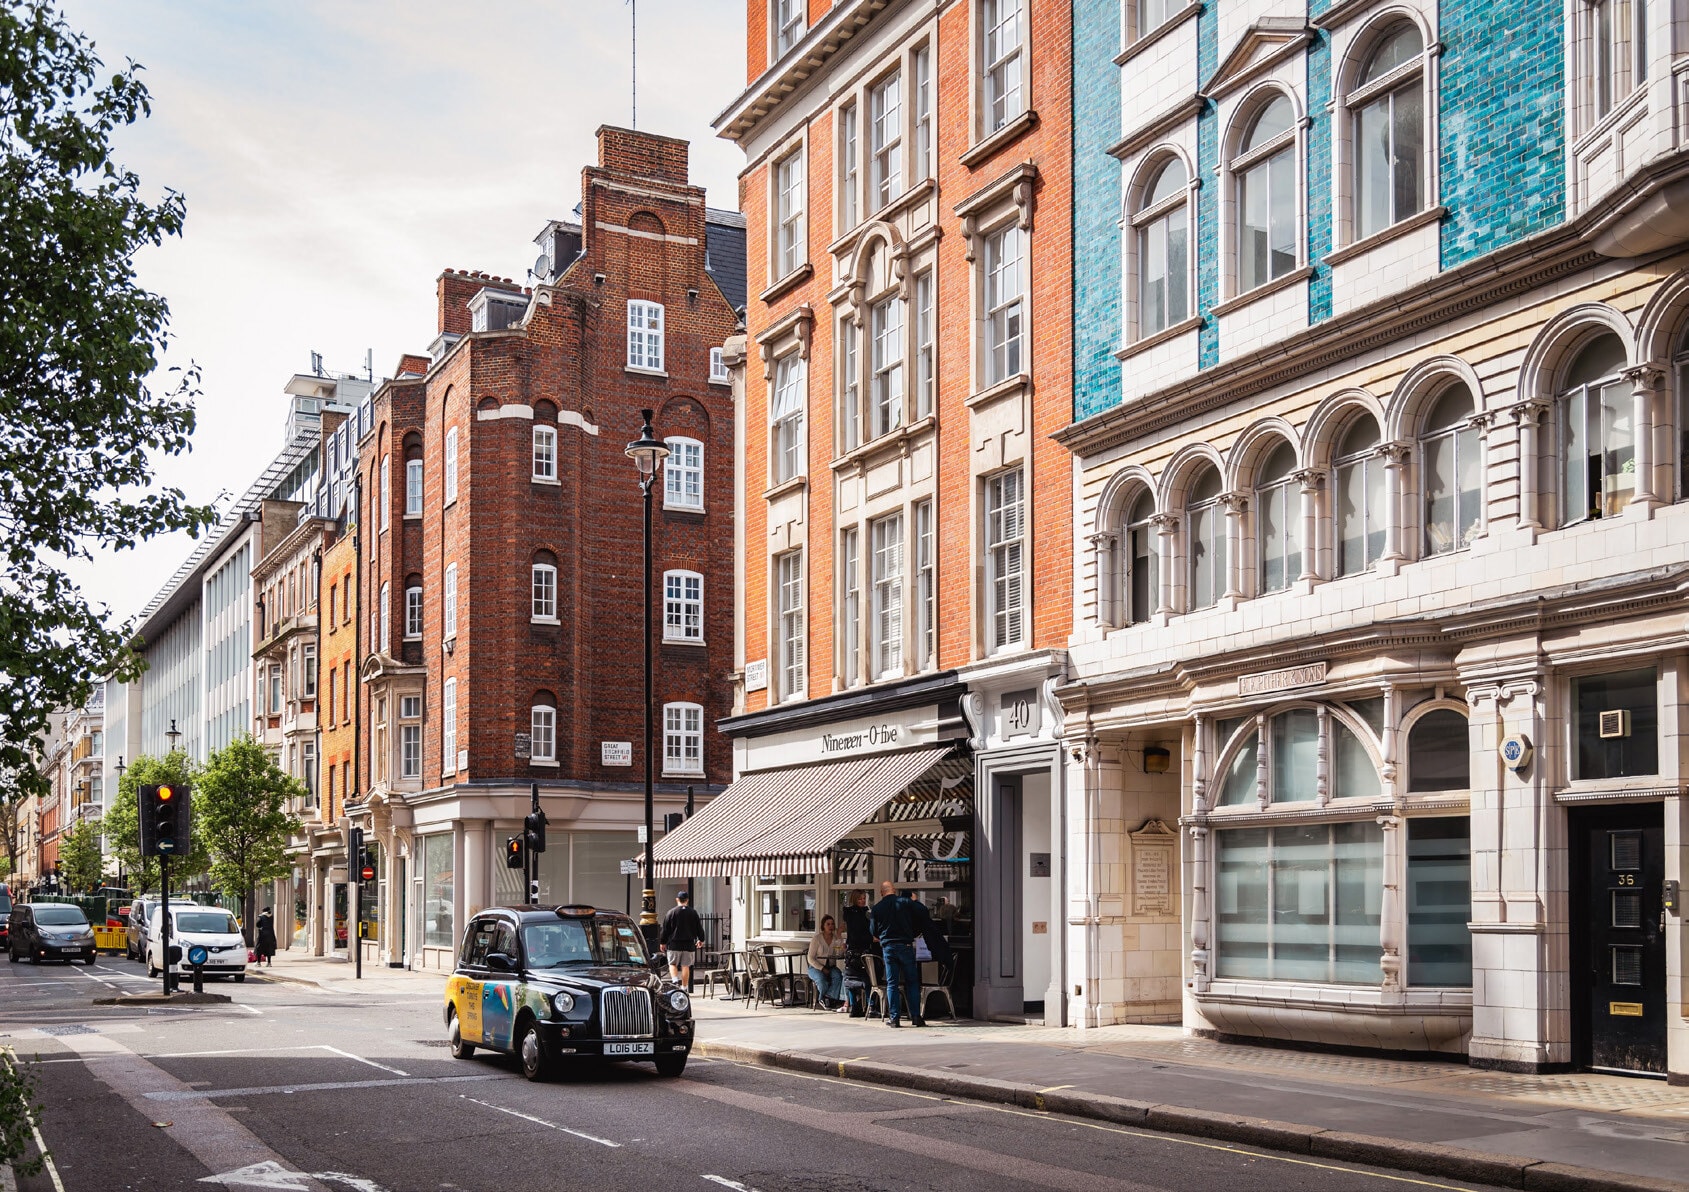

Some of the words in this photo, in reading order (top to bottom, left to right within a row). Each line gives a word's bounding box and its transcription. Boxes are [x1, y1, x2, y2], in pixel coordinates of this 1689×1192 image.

[1298, 665, 1322, 684] SONS
[1009, 699, 1029, 729] 40
[1618, 874, 1634, 885] 36
[609, 1043, 630, 1053] LO16
[632, 1043, 649, 1053] UEZ
